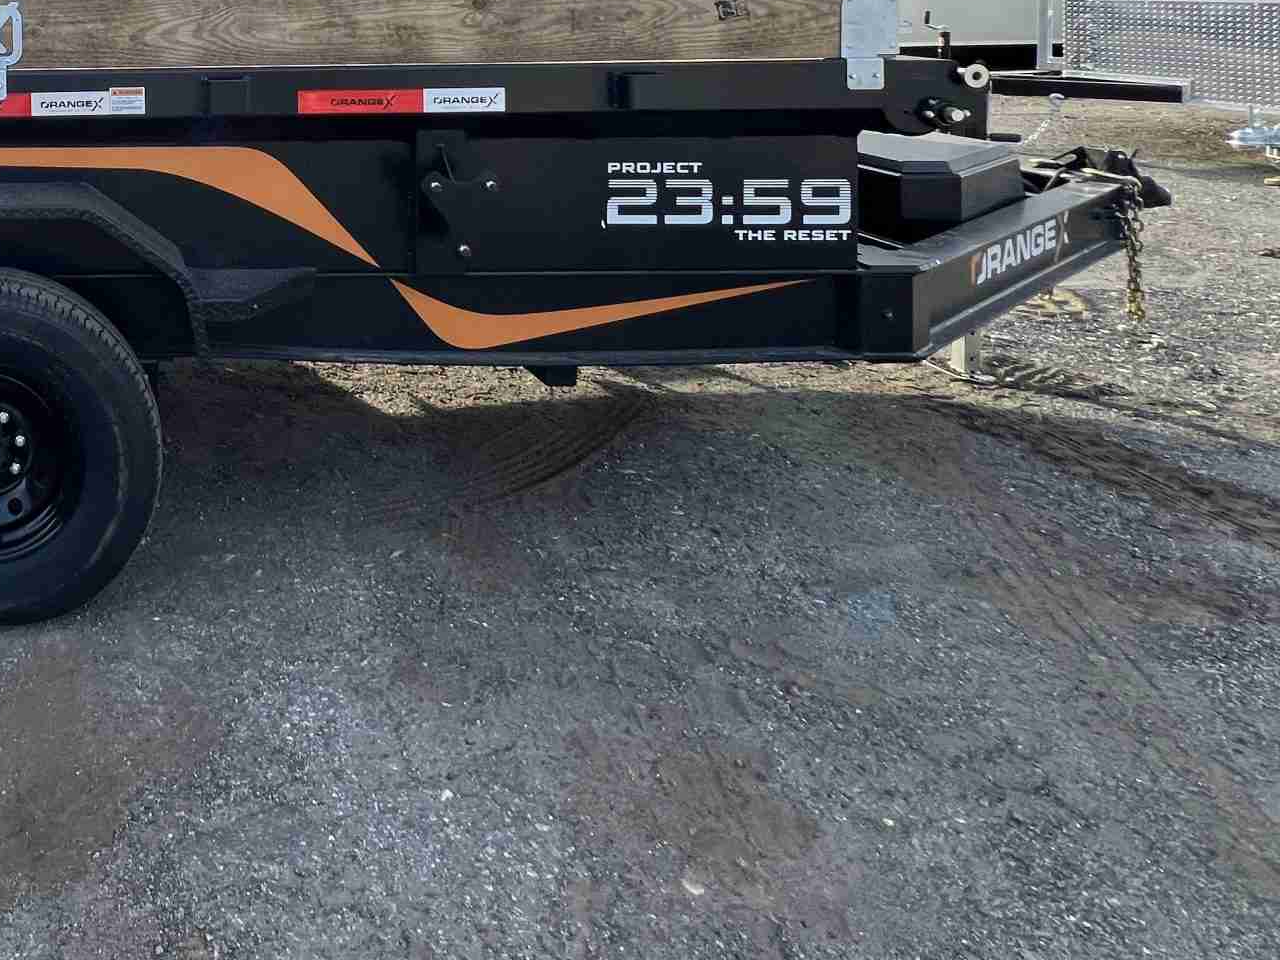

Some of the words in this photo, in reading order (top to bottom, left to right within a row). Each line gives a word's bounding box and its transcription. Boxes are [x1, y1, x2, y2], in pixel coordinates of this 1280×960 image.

[607, 162, 703, 174] PROJECT
[606, 179, 852, 225] 23:59
[734, 230, 776, 241] THE
[783, 230, 852, 241] RESET
